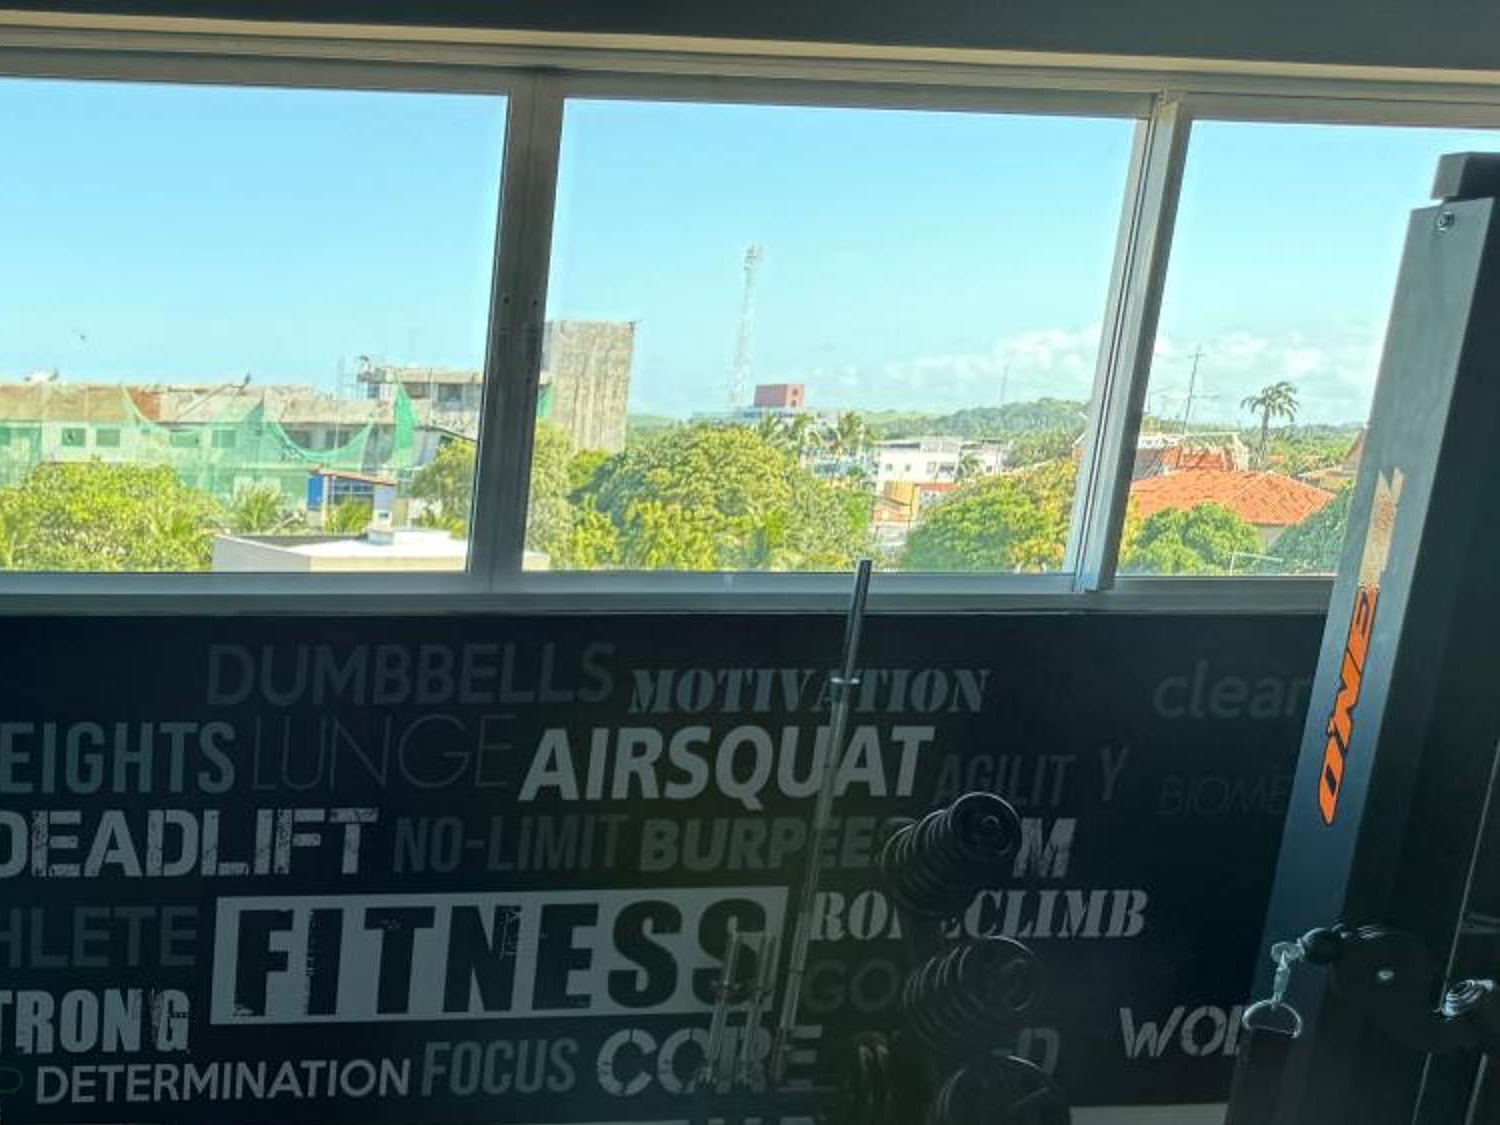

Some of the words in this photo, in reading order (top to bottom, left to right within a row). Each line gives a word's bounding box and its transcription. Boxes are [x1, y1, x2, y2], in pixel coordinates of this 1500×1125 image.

[207, 641, 617, 705] DUMBBELLS
[627, 667, 991, 715] MOTIVATION
[250, 712, 516, 792] LUNGE
[518, 724, 936, 811] AIRSQUAT
[392, 812, 631, 875] NO-LIMIT
[233, 897, 768, 1019] FITNESS
[35, 1057, 410, 1106] DETERMINATION
[420, 1037, 579, 1098] FOCUS
[596, 1023, 824, 1097] CORE
